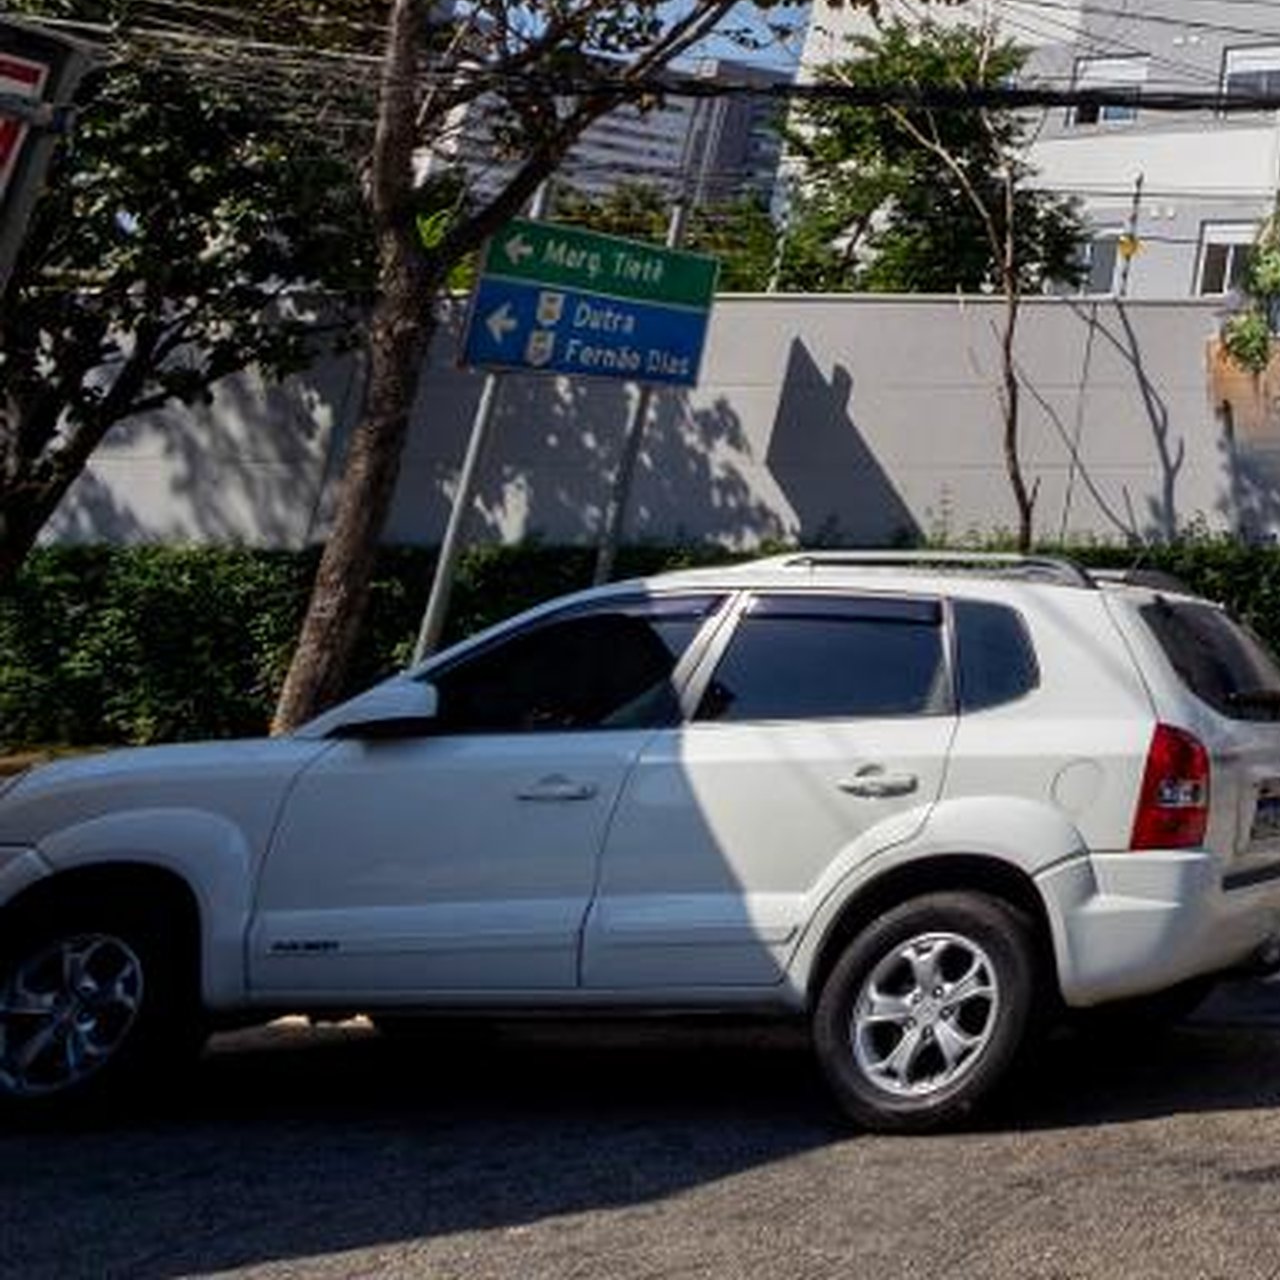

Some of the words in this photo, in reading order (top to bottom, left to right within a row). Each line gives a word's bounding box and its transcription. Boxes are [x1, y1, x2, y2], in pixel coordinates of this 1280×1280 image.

[613, 251, 664, 283] Tietê
[572, 300, 635, 333] Dutra
[564, 338, 641, 371] Fernão
[647, 348, 690, 376] Dias
